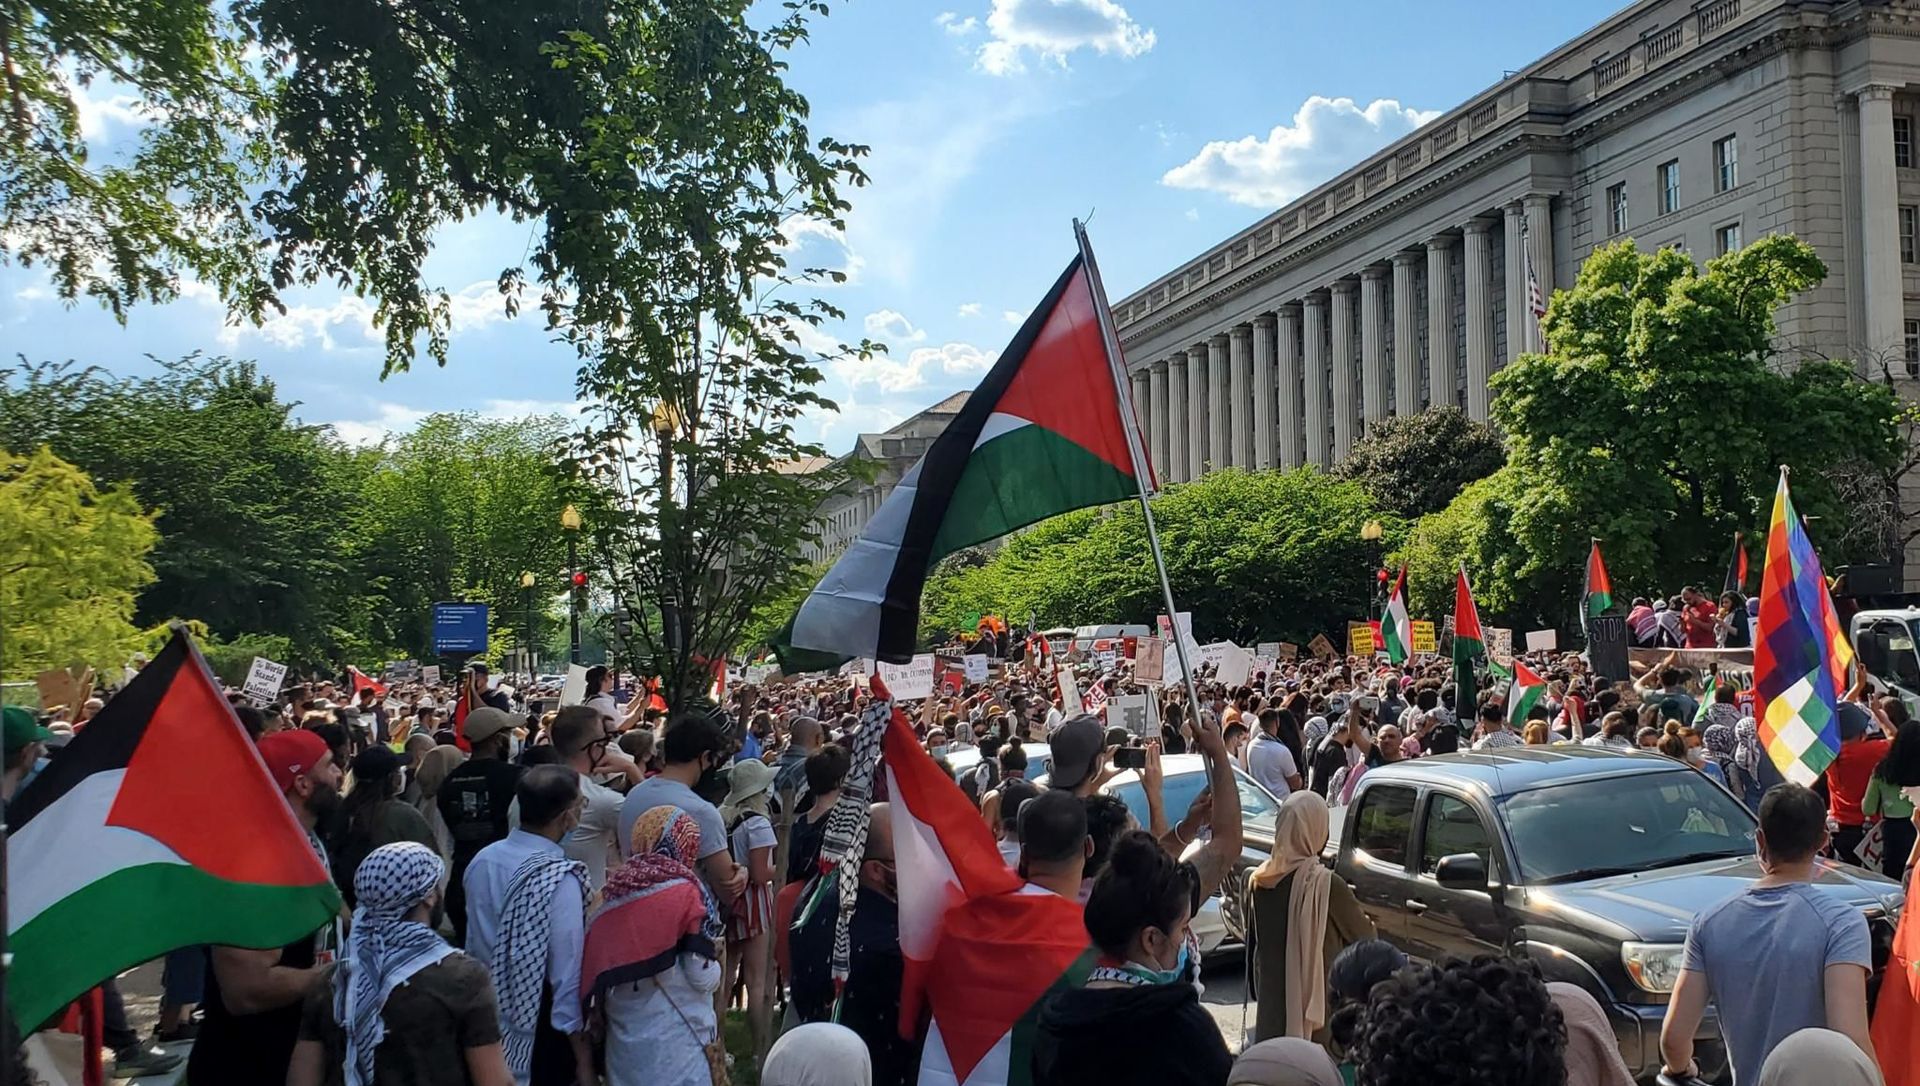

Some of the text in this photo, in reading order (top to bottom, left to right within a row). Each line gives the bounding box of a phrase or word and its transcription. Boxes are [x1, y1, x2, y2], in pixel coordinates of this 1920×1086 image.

[1593, 616, 1622, 643] STOP
[255, 669, 277, 683] Stands
[245, 681, 276, 698] Palestine
